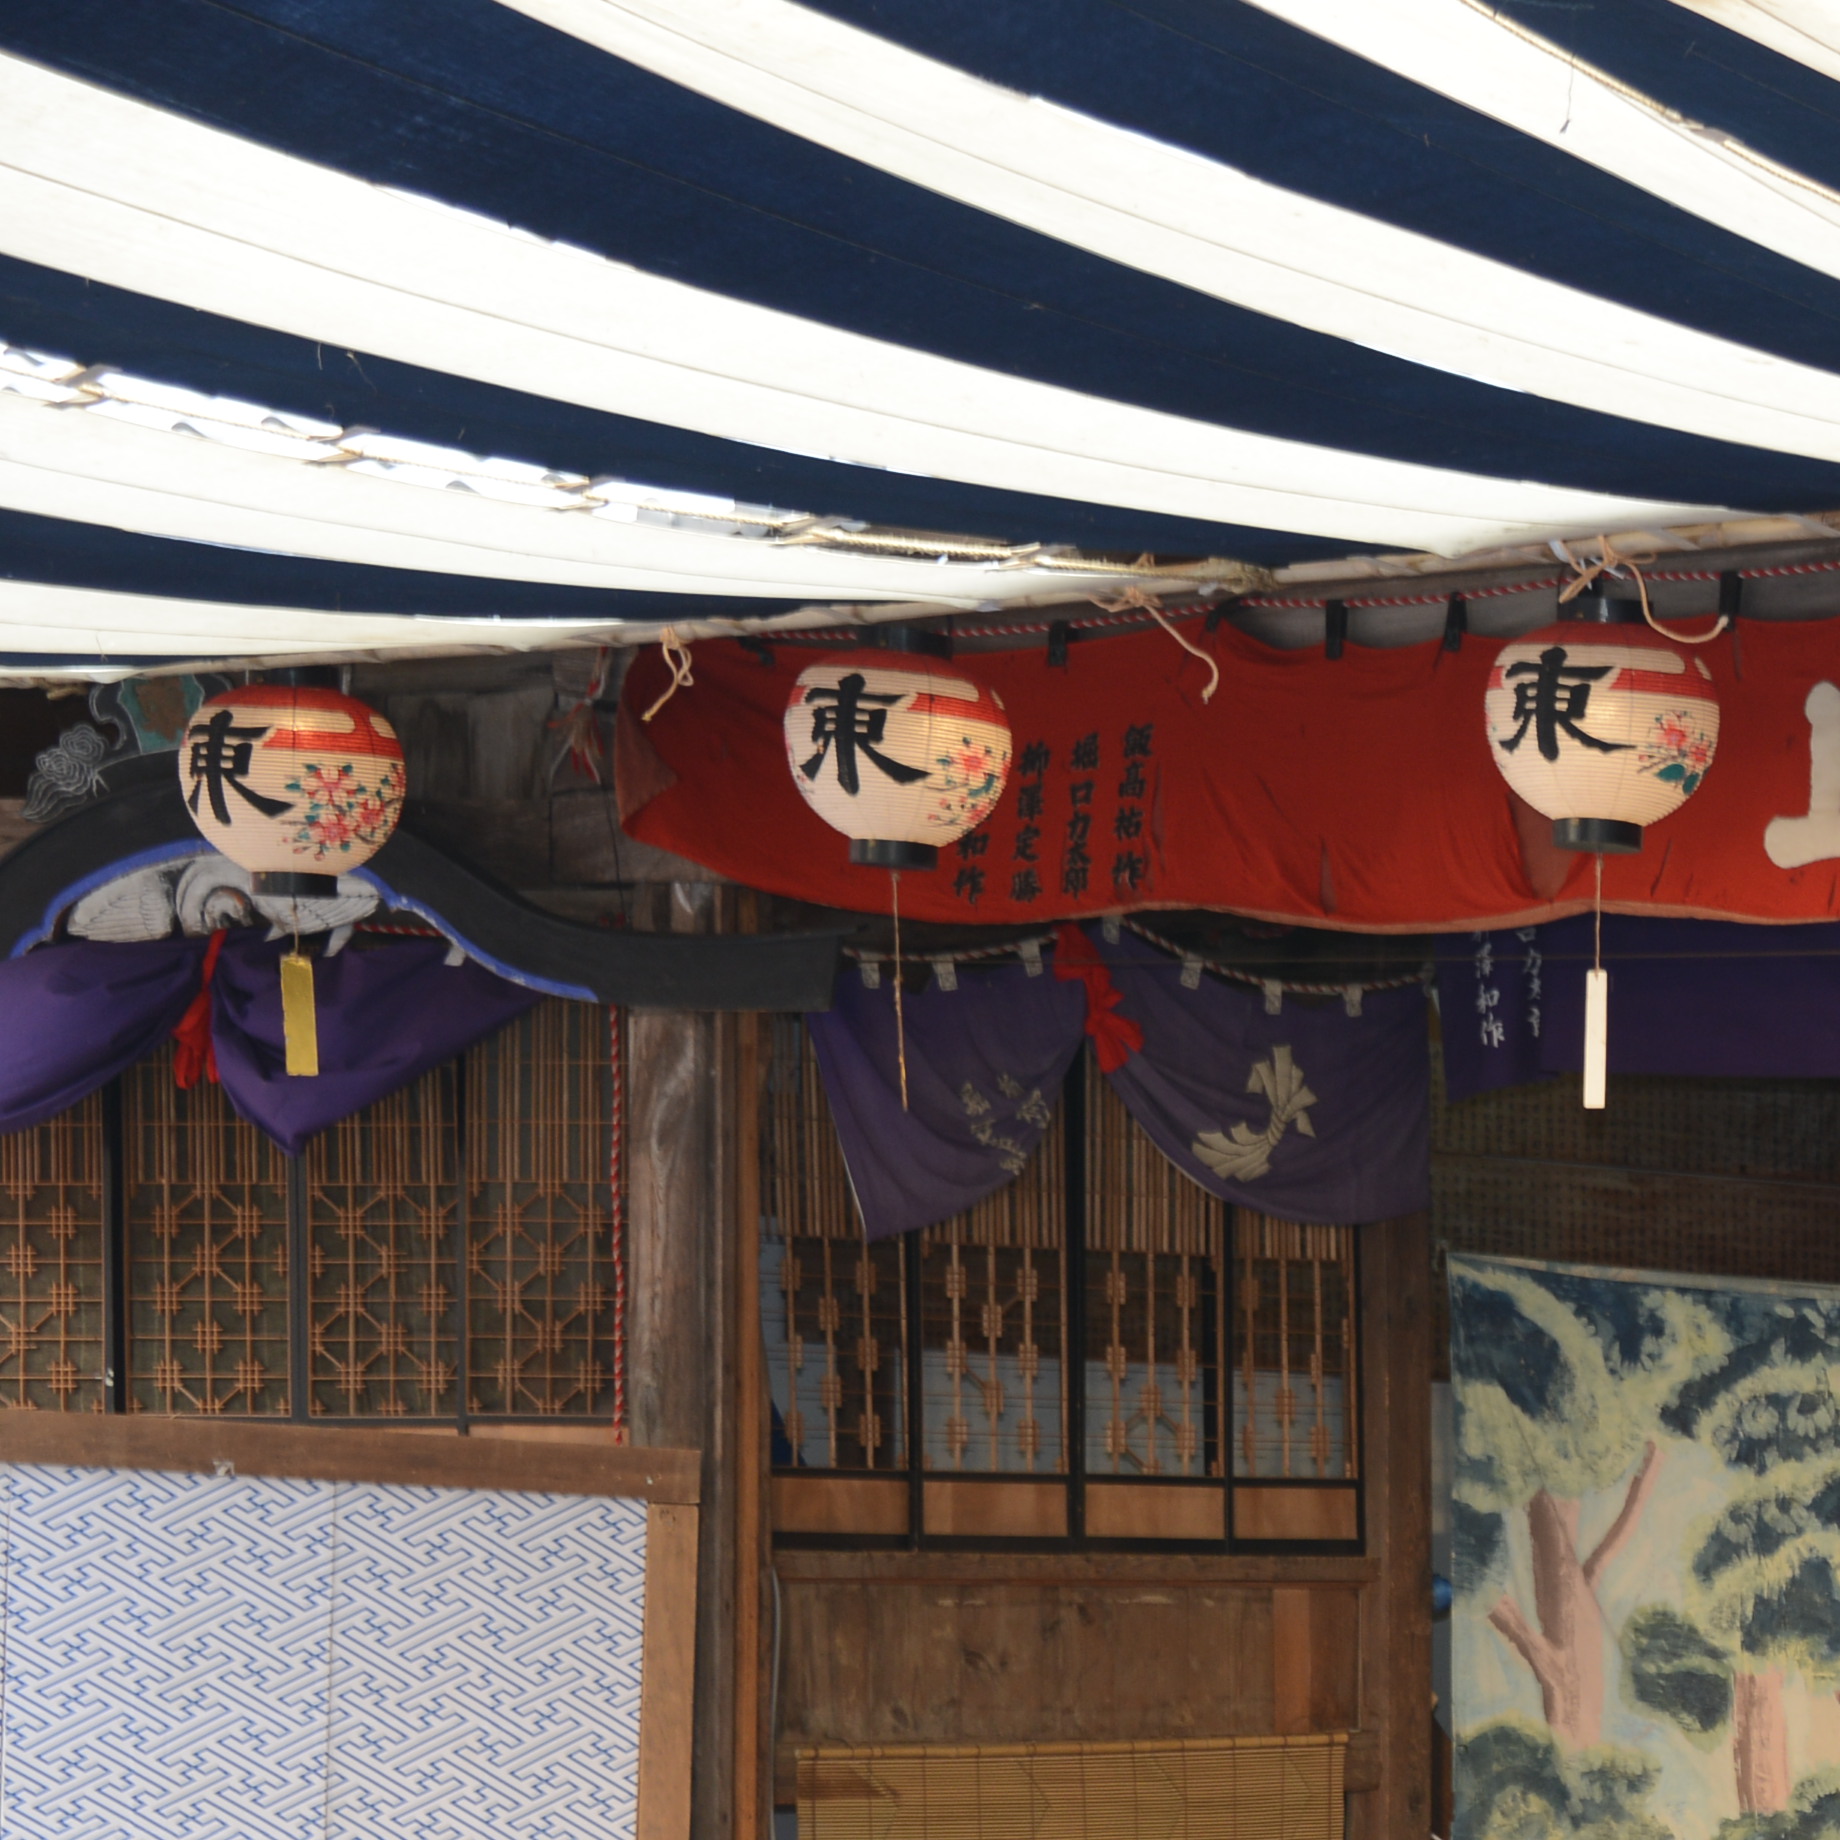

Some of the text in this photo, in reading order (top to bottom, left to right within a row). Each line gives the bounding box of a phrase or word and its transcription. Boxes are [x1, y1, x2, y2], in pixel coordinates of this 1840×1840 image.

[800, 673, 930, 794] 東
[1500, 646, 1635, 762] 東
[188, 709, 294, 825] 東
[953, 828, 990, 905] 和作
